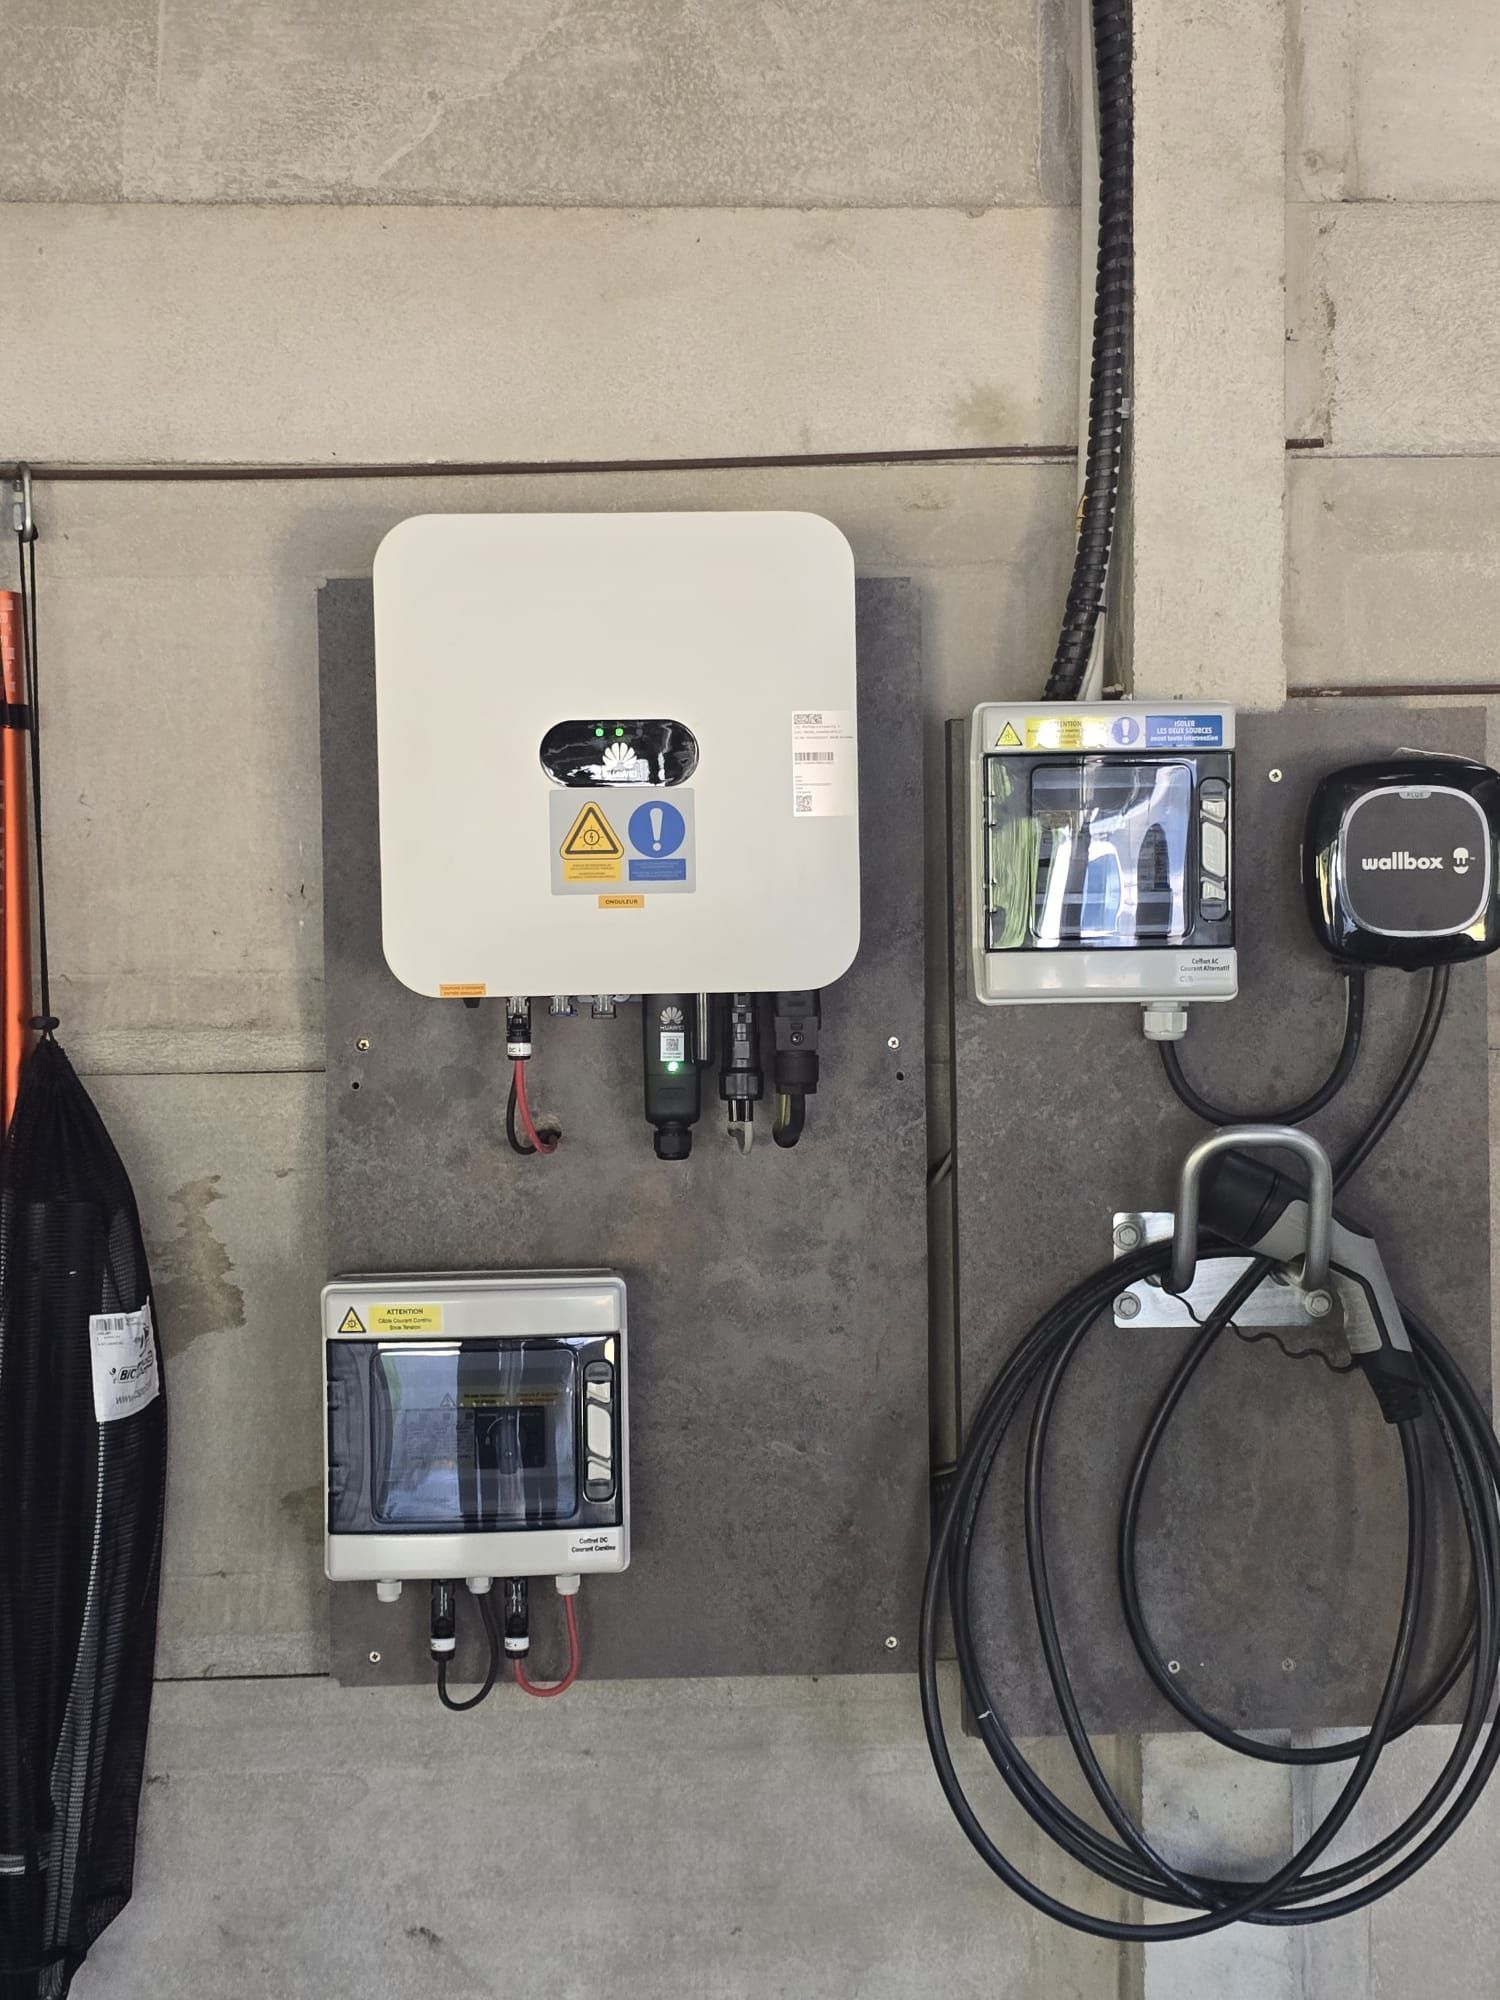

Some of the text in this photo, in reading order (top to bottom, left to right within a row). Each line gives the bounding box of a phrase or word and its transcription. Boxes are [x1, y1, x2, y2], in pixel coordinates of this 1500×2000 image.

[1156, 727, 1213, 735] LES DEUX SOURCES
[1362, 851, 1444, 870] wallbox
[1211, 957, 1219, 965] AC
